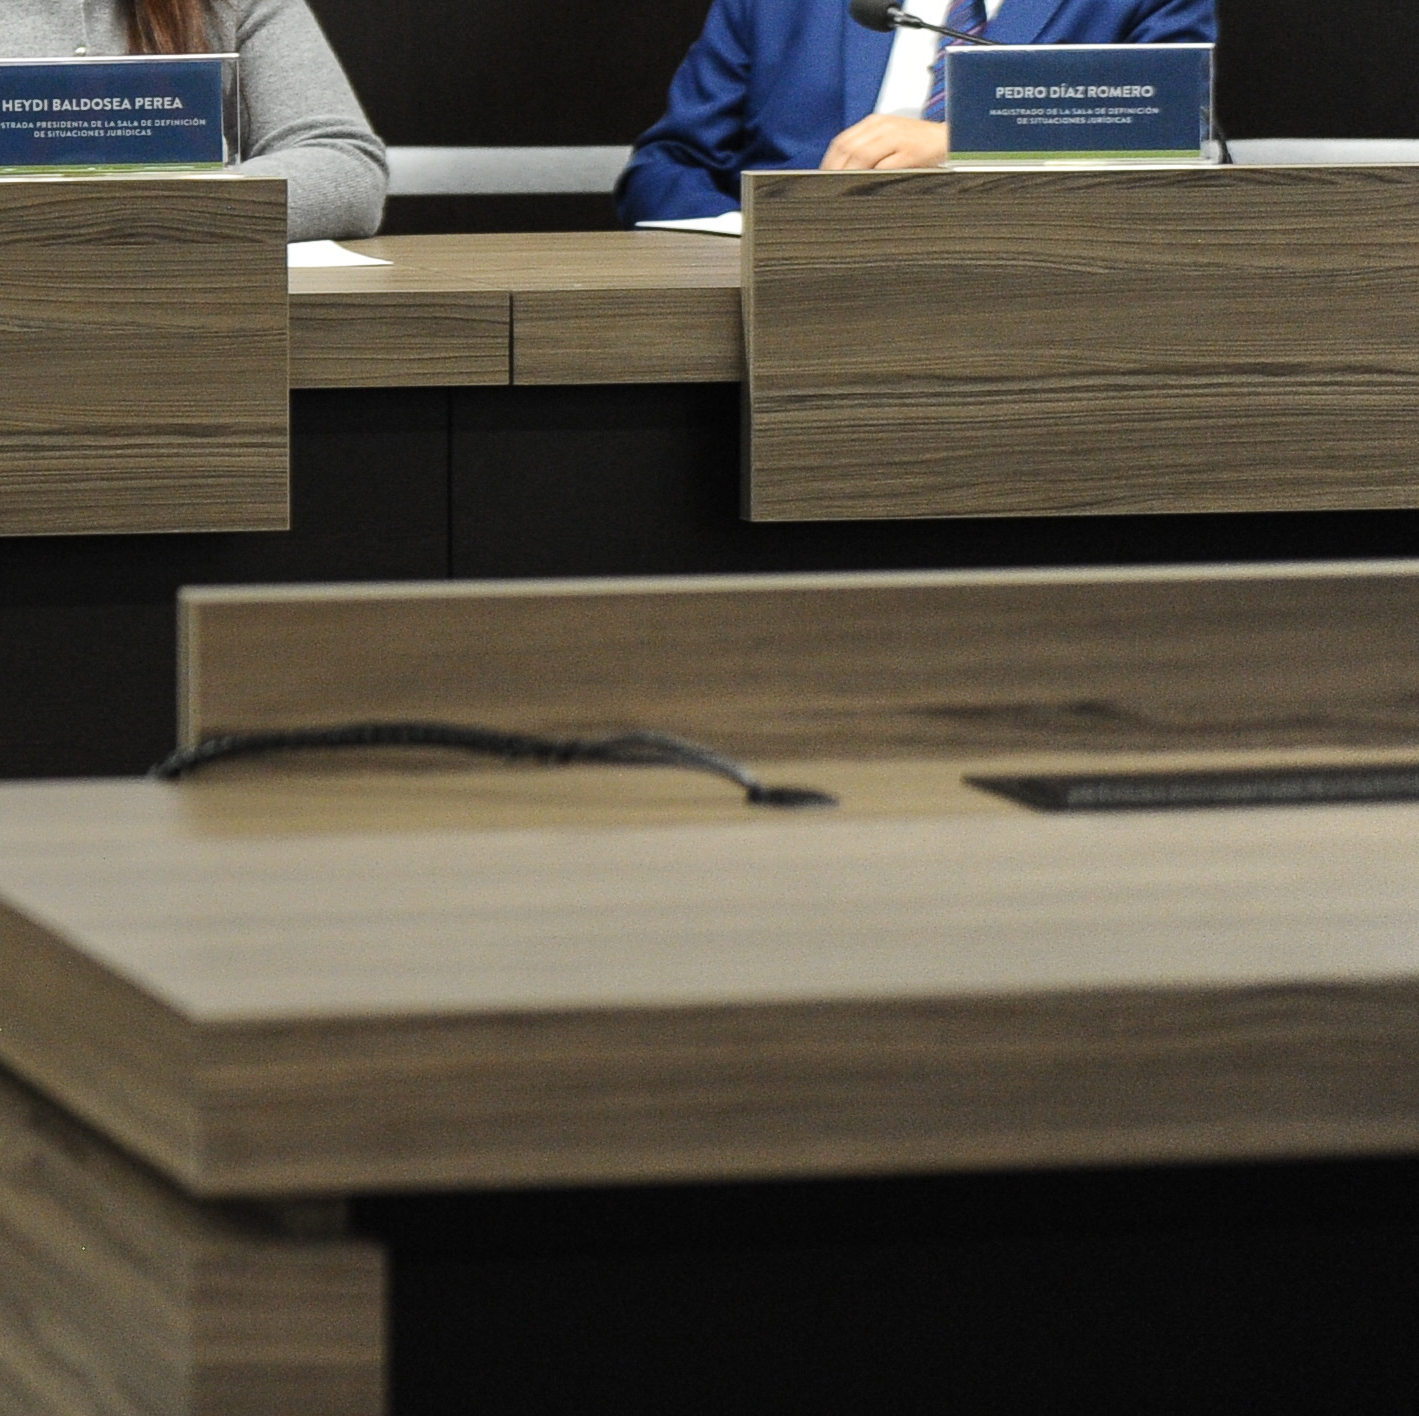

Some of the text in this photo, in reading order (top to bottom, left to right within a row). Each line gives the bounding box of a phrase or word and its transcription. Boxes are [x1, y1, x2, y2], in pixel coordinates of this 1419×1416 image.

[996, 83, 1153, 99] PEDRO DÍAZ ROMERO
[2, 97, 183, 112] HEYDI BALDOSEA PEREA
[155, 118, 206, 127] DEFINICIÓN
[107, 128, 152, 136] JURÍDICAS
